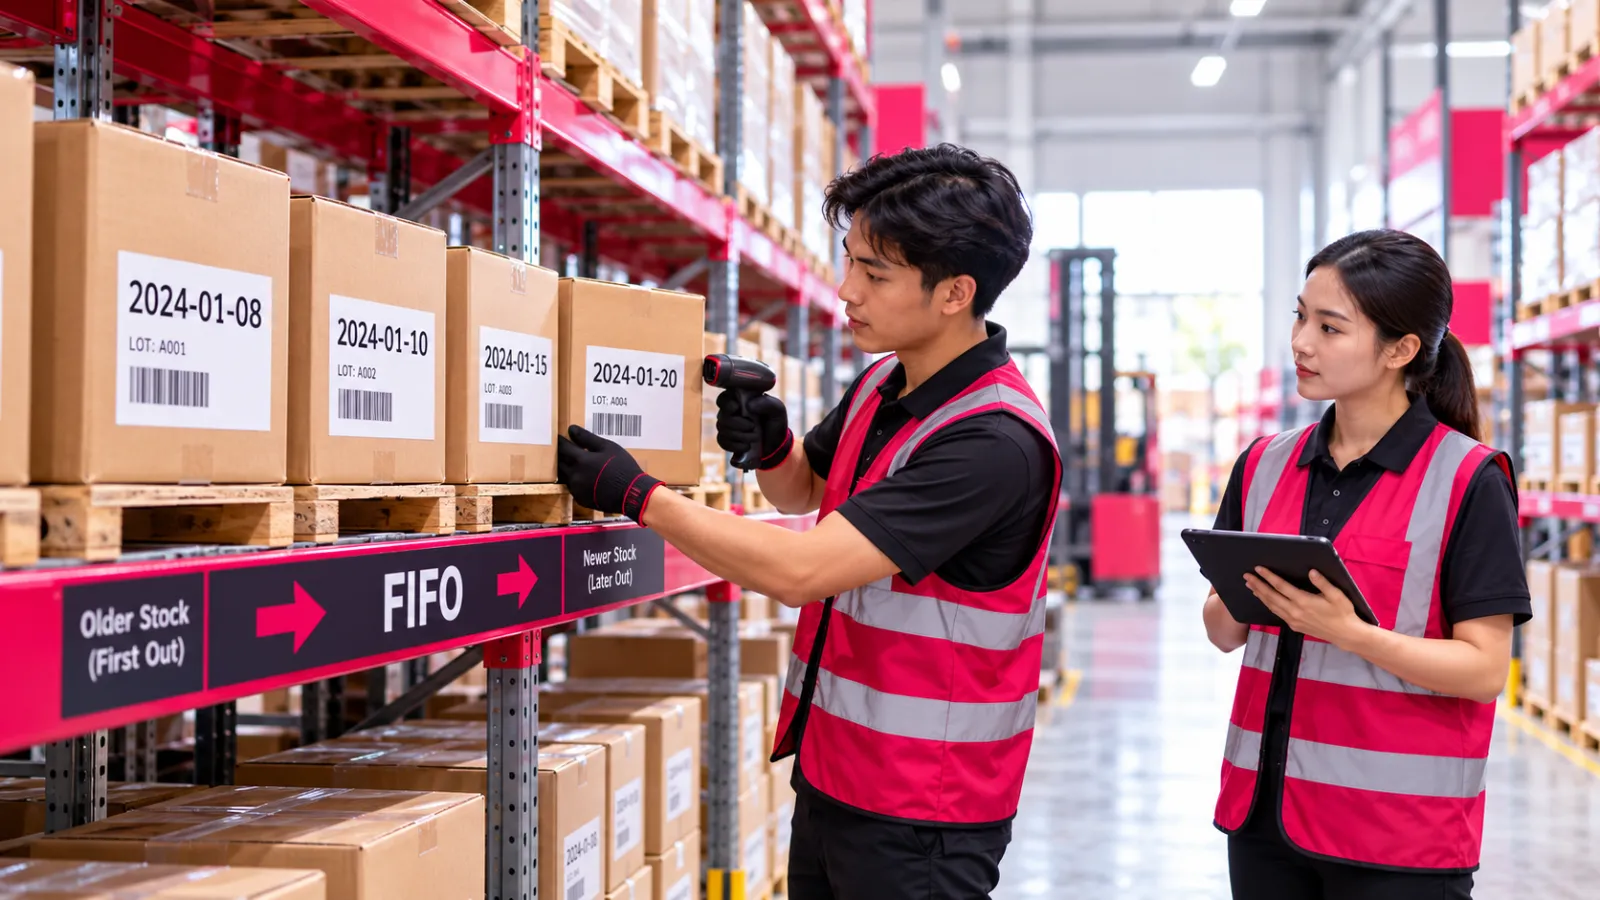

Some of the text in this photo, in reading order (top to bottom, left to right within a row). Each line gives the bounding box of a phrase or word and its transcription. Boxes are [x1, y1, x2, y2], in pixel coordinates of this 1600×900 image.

[129, 279, 262, 329] 2024-01-08
[129, 336, 186, 357] LOT: A001
[337, 317, 428, 357] 2024-01-10
[337, 364, 377, 380] LOT: A002
[484, 345, 548, 376] 2024-01-15
[593, 361, 678, 388] 2024-01-20
[484, 382, 512, 396] LOT: A003
[592, 395, 628, 407] LOT: A004
[583, 544, 637, 567] Newer Stock
[587, 568, 633, 594] (Later Out)
[384, 565, 464, 633] FIFO
[80, 599, 191, 640] Older Stock
[88, 637, 186, 681] (First Out)
